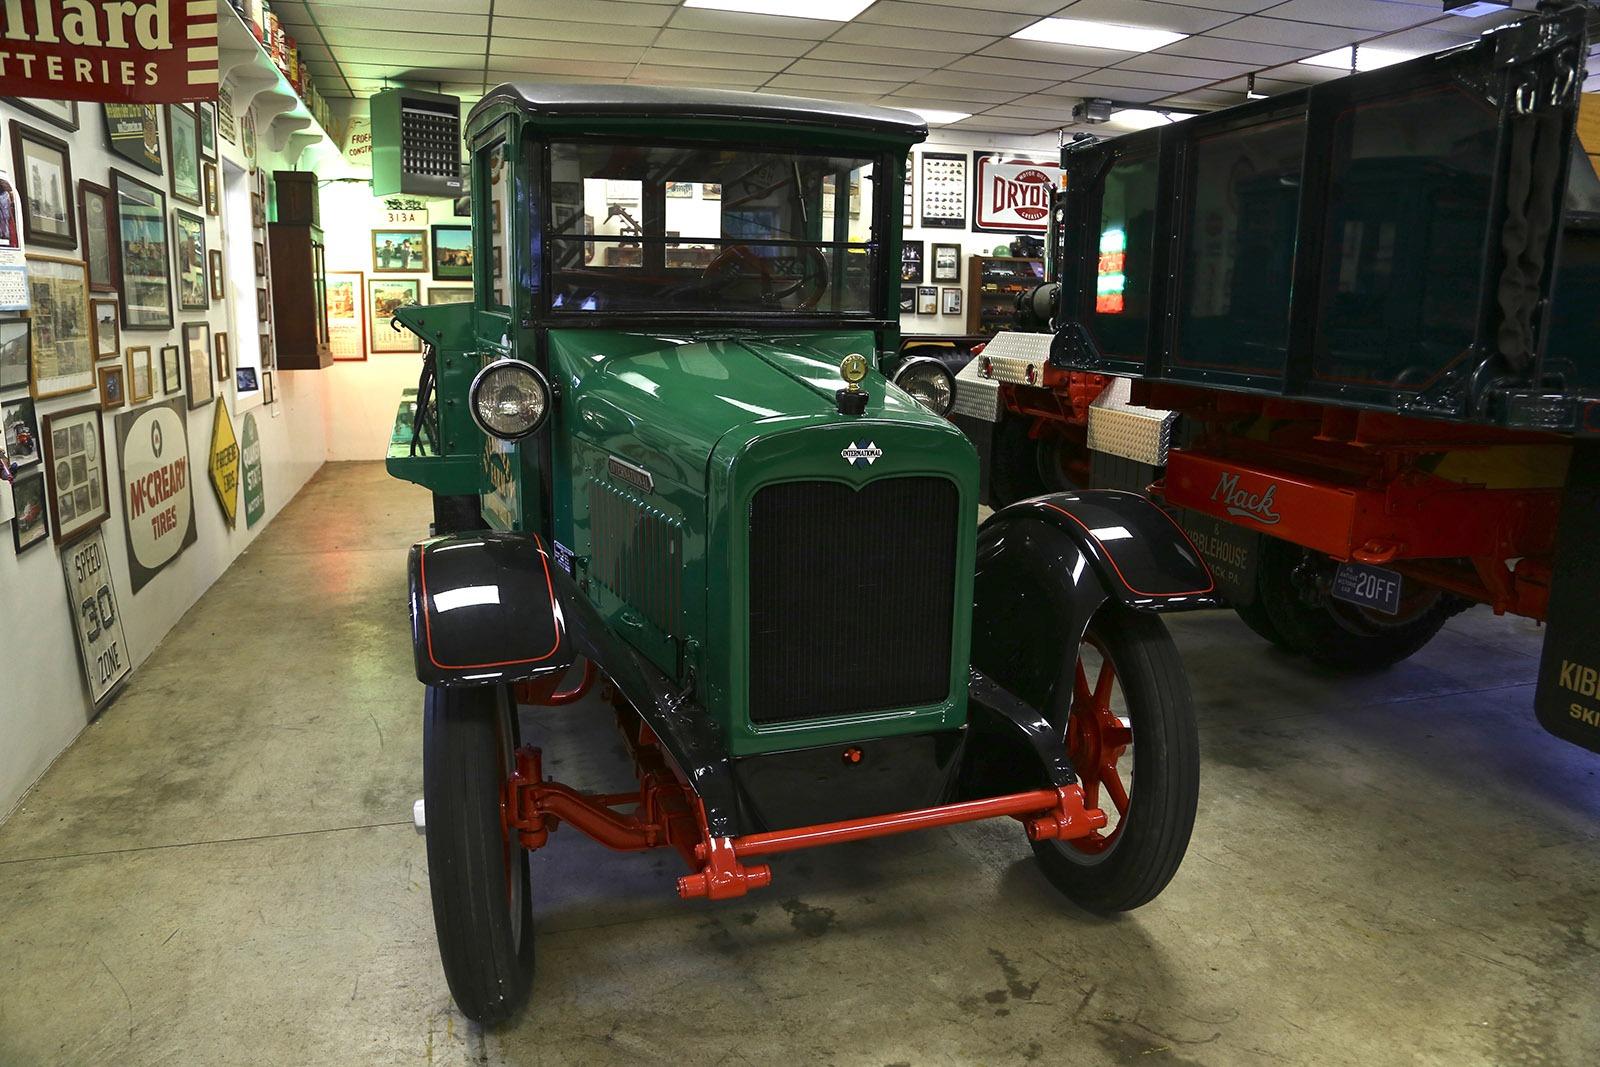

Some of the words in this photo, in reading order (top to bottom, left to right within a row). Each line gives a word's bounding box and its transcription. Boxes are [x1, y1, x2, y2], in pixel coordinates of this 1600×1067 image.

[388, 212, 415, 223] 313A
[842, 449, 880, 457] INTERNATIONAL
[1211, 471, 1280, 522] Mack
[151, 504, 177, 540] TIRES
[75, 542, 101, 583] SPEED
[1355, 572, 1396, 602] 20FF
[81, 584, 115, 643] 30
[97, 642, 121, 684] ZONE
[1559, 660, 1600, 701] KIB
